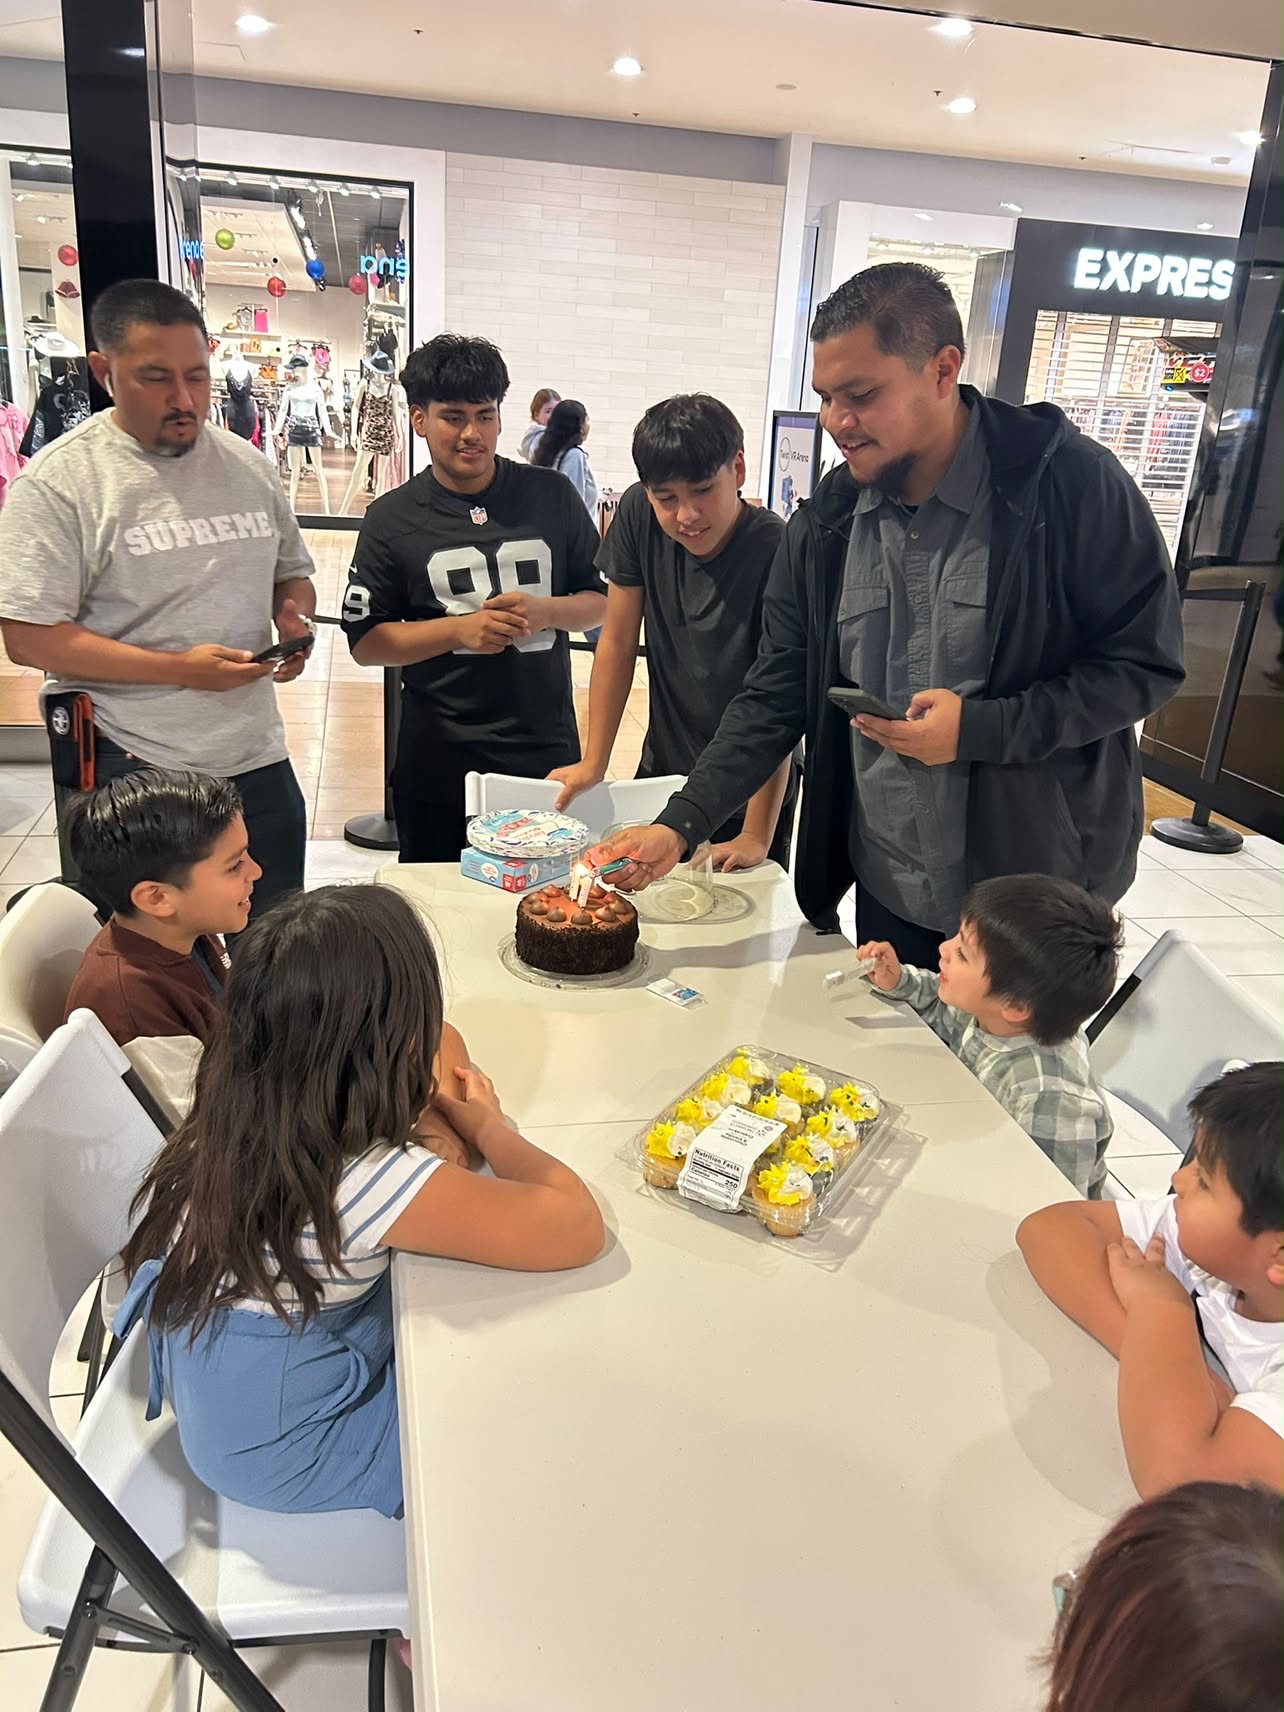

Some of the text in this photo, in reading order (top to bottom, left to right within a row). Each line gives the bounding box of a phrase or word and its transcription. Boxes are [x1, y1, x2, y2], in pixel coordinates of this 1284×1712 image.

[1073, 247, 1236, 301] EXPRES
[1194, 368, 1206, 378] $2
[124, 511, 273, 556] SUPREME
[694, 1149, 721, 1163] Nutrition
[722, 1160, 740, 1172] Facts
[724, 1180, 738, 1189] 250
